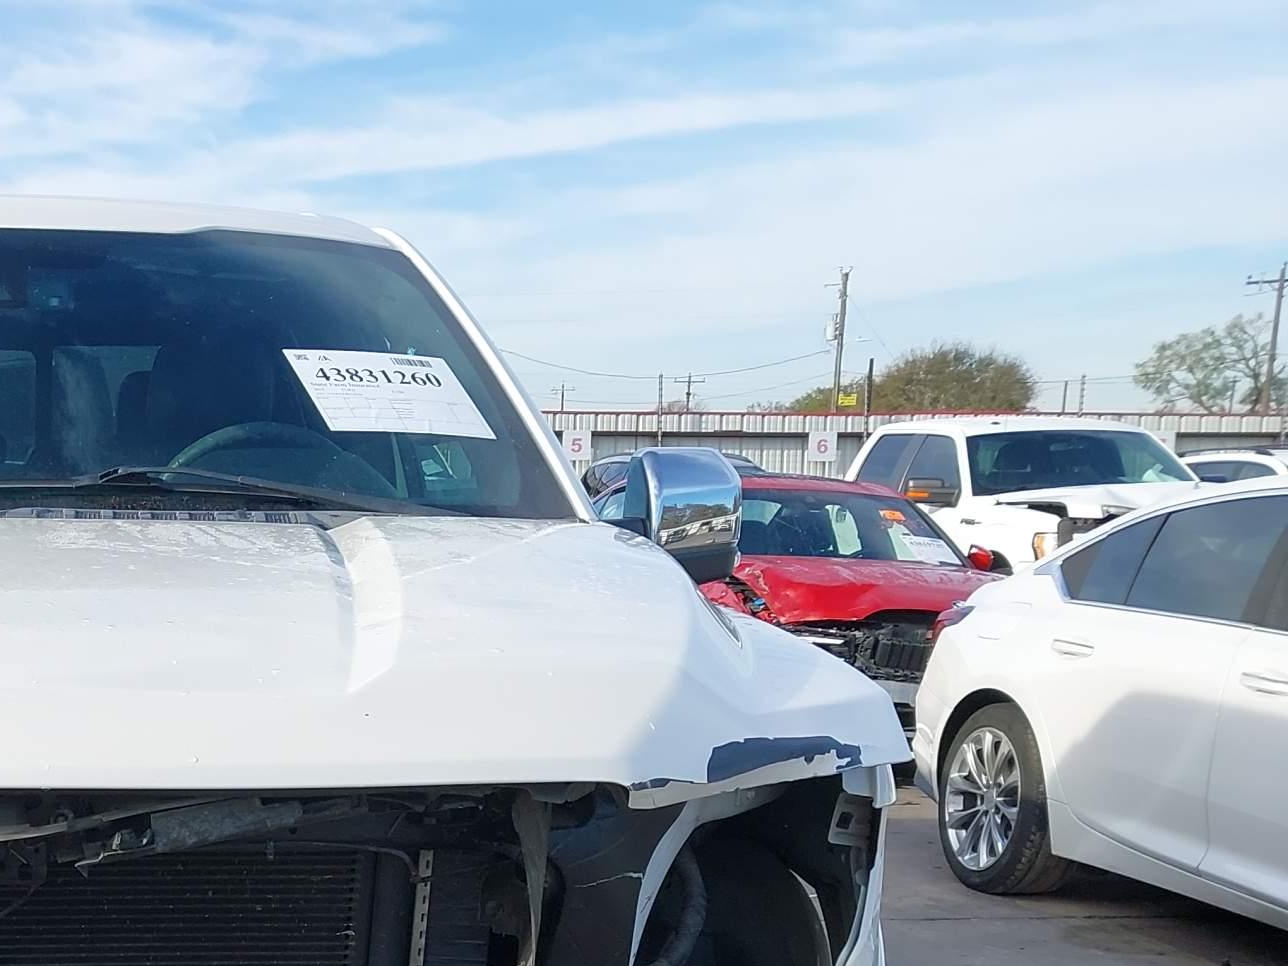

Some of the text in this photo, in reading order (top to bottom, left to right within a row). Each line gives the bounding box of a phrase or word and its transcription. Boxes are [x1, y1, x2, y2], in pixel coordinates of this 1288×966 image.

[315, 367, 442, 388] 43831260
[571, 438, 583, 453] 5
[817, 439, 828, 454] 6
